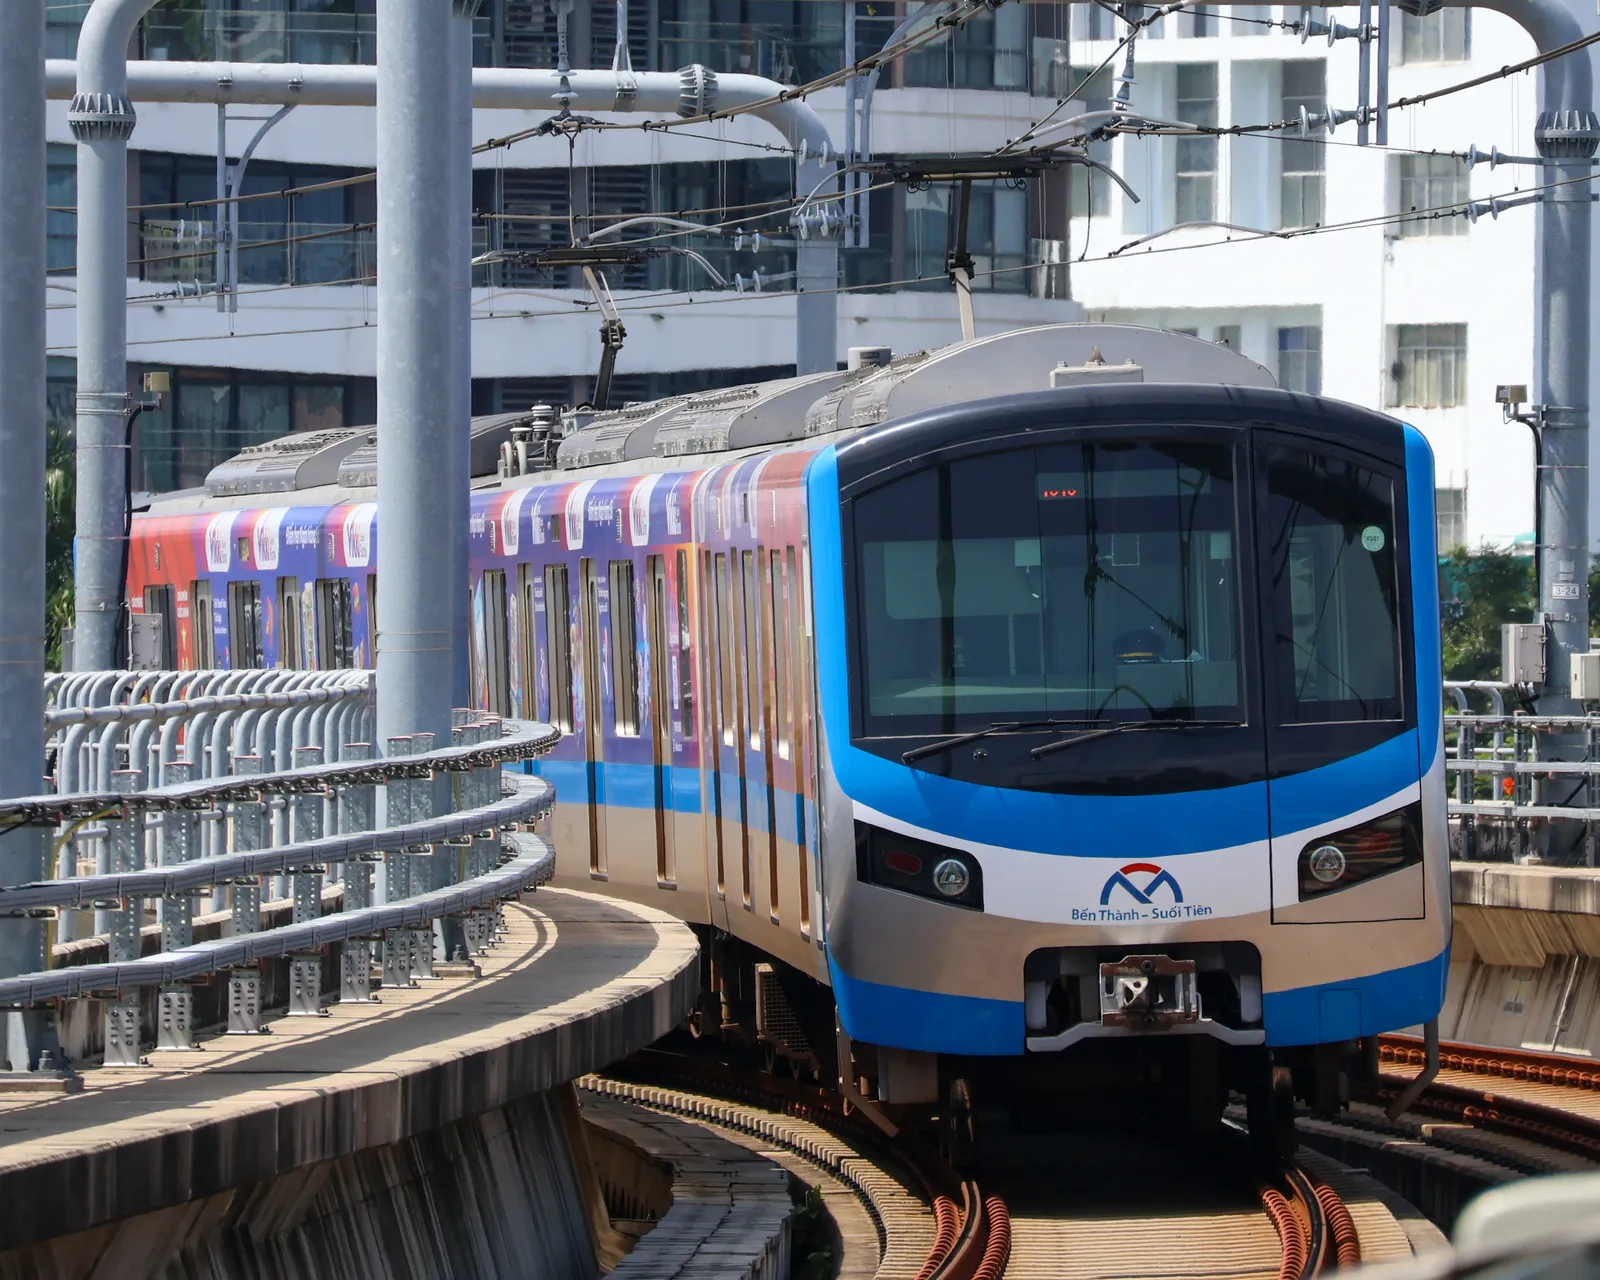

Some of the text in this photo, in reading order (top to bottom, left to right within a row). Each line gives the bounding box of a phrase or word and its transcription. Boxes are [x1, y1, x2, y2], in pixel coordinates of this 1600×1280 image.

[1555, 586, 1577, 596] 3-24
[1071, 908, 1096, 921] Bến
[1098, 909, 1140, 922] Thành
[1151, 905, 1182, 919] Suối
[1183, 904, 1213, 917] Tiên
